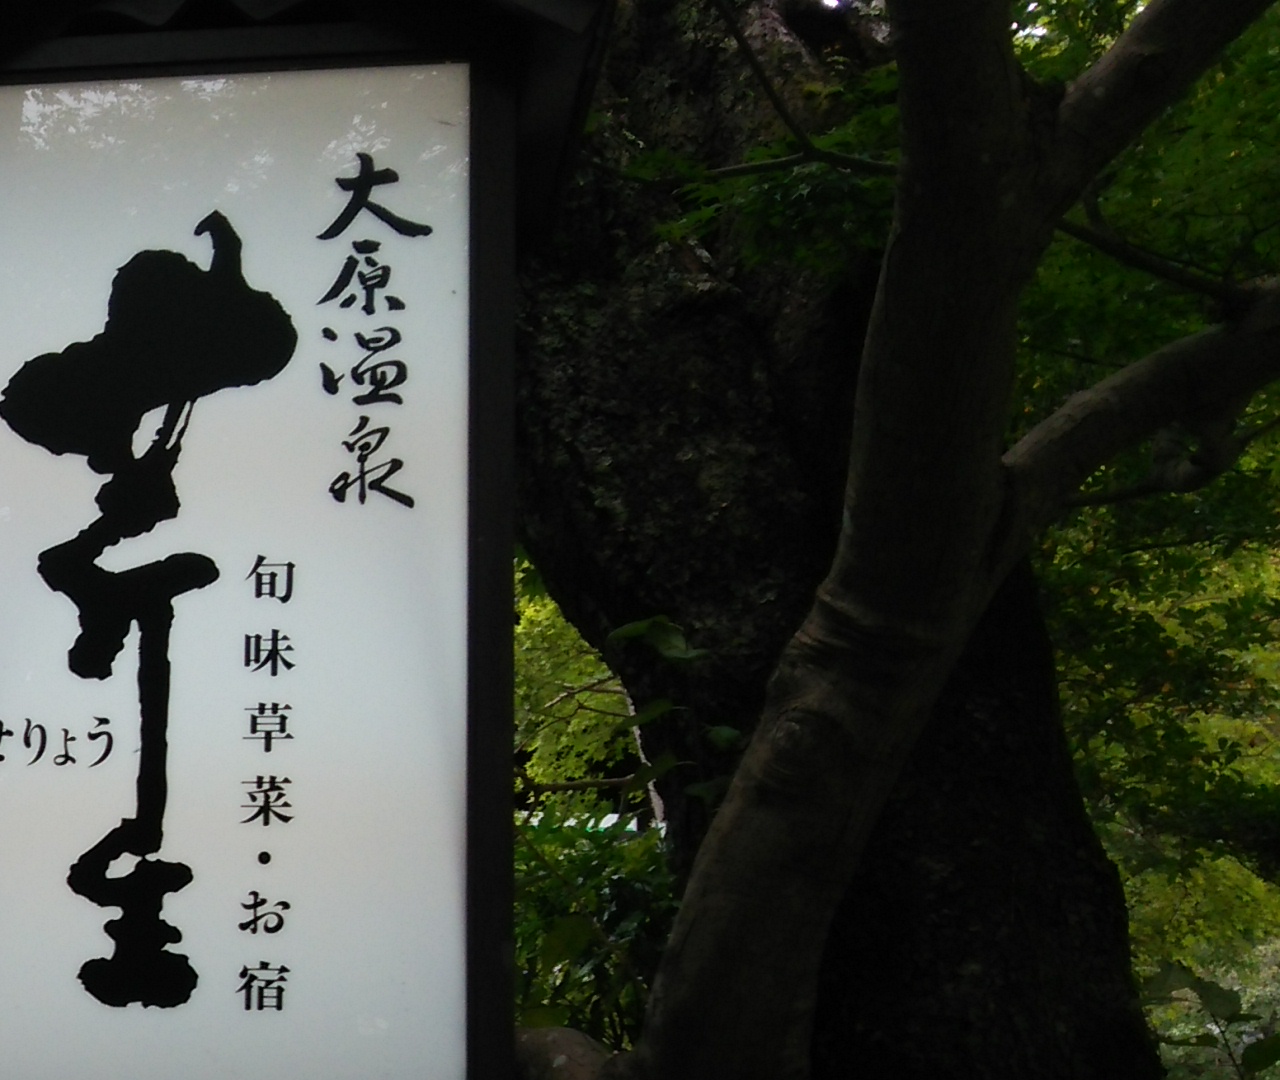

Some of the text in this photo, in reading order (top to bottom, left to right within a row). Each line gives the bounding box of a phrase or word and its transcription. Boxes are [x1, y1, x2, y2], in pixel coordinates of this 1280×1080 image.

[315, 151, 433, 510] 大原温泉
[236, 553, 297, 1012] 旬味草菜・お宿
